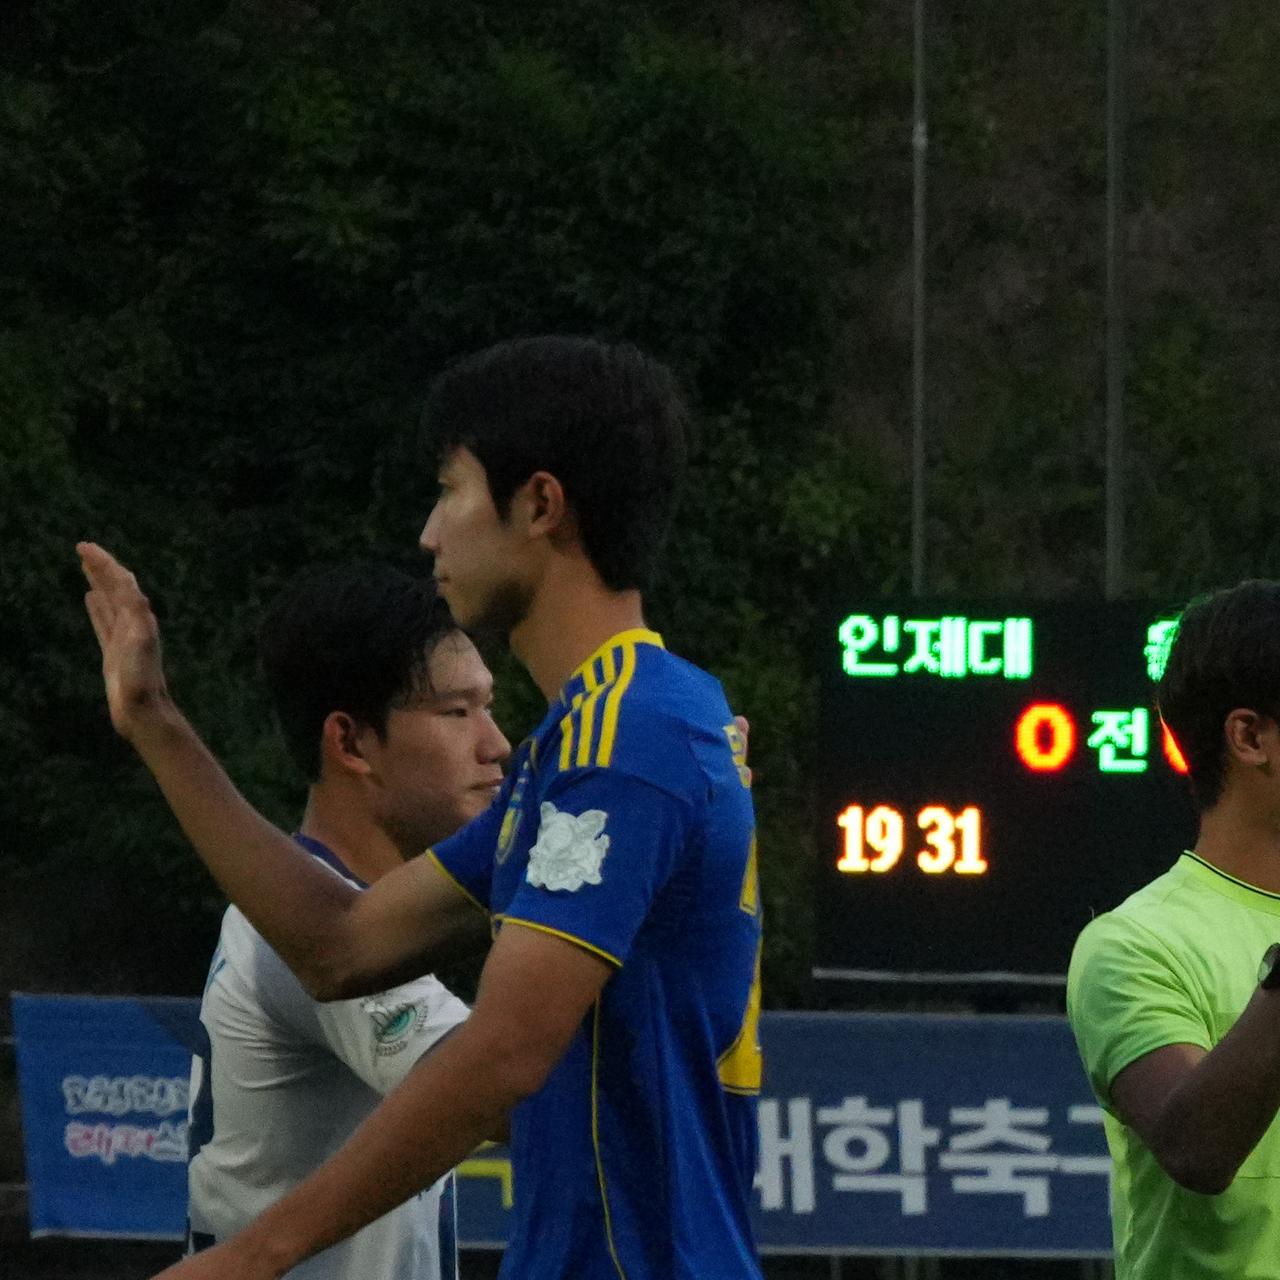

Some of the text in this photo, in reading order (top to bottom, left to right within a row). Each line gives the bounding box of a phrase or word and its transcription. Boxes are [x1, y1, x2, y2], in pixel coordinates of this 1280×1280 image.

[837, 613, 1034, 680] 인제대
[1014, 701, 1149, 774] 0 전
[835, 804, 988, 875] 19 31
